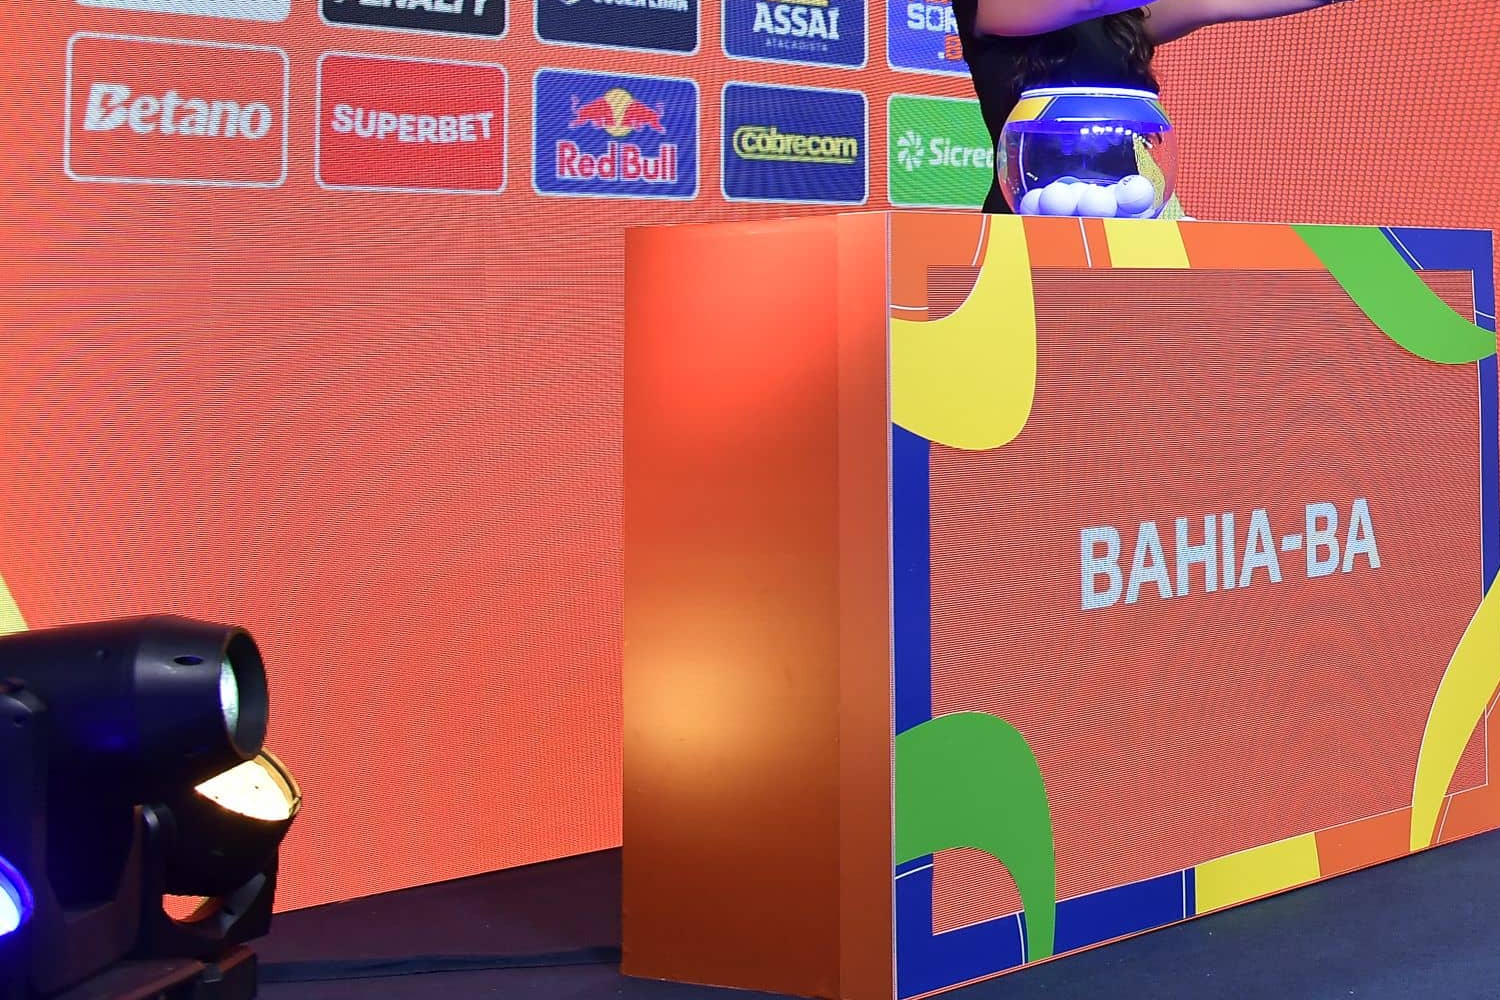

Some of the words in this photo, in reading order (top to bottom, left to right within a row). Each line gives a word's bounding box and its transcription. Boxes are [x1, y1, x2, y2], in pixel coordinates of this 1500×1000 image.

[907, 3, 959, 35] SOR
[83, 82, 273, 140] Betano
[331, 103, 495, 144] SUPERBET
[555, 139, 618, 181] Red
[619, 142, 677, 184] Bull
[929, 137, 994, 168] Sicre
[1079, 497, 1381, 611] BAHIA-BA
